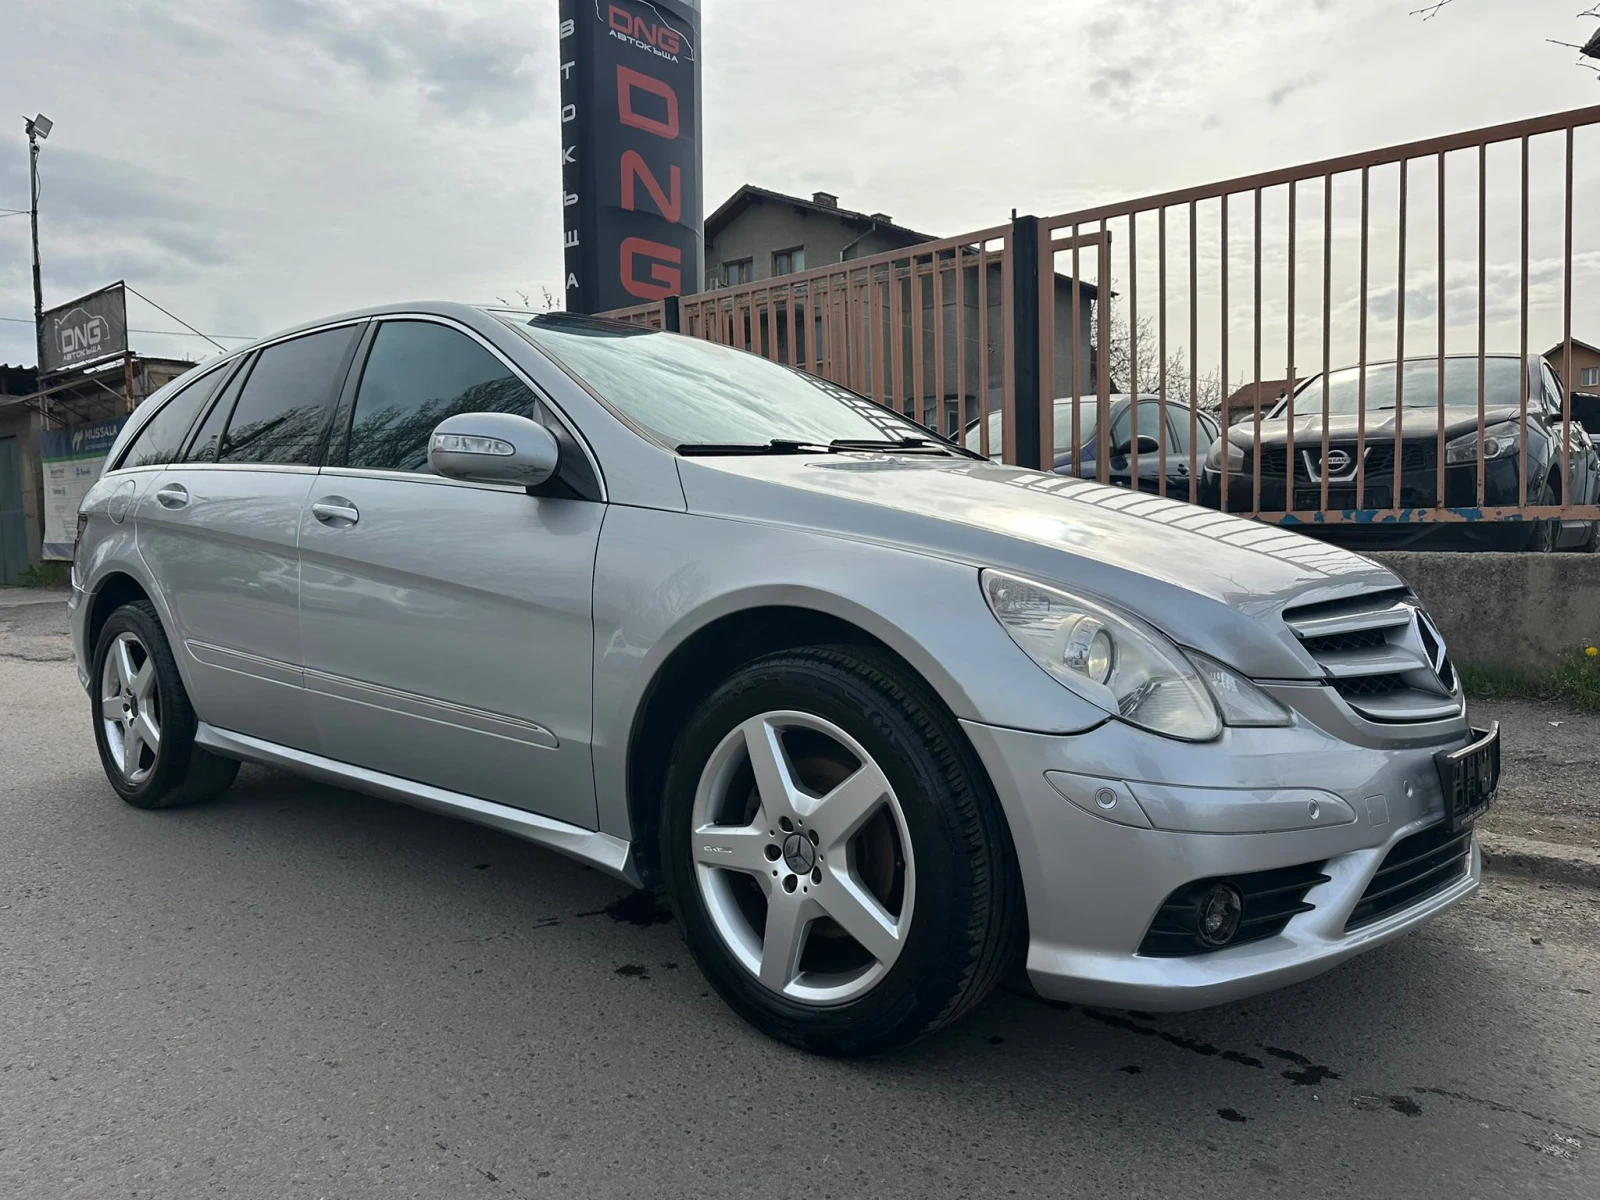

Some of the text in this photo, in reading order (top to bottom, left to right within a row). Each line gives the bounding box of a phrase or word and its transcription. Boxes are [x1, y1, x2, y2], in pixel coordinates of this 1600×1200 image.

[608, 4, 680, 55] DNG
[608, 29, 679, 64] АВТОКЪЩА
[616, 63, 682, 301] DNG
[61, 318, 101, 354] DNG
[84, 424, 118, 440] MUSSALA
